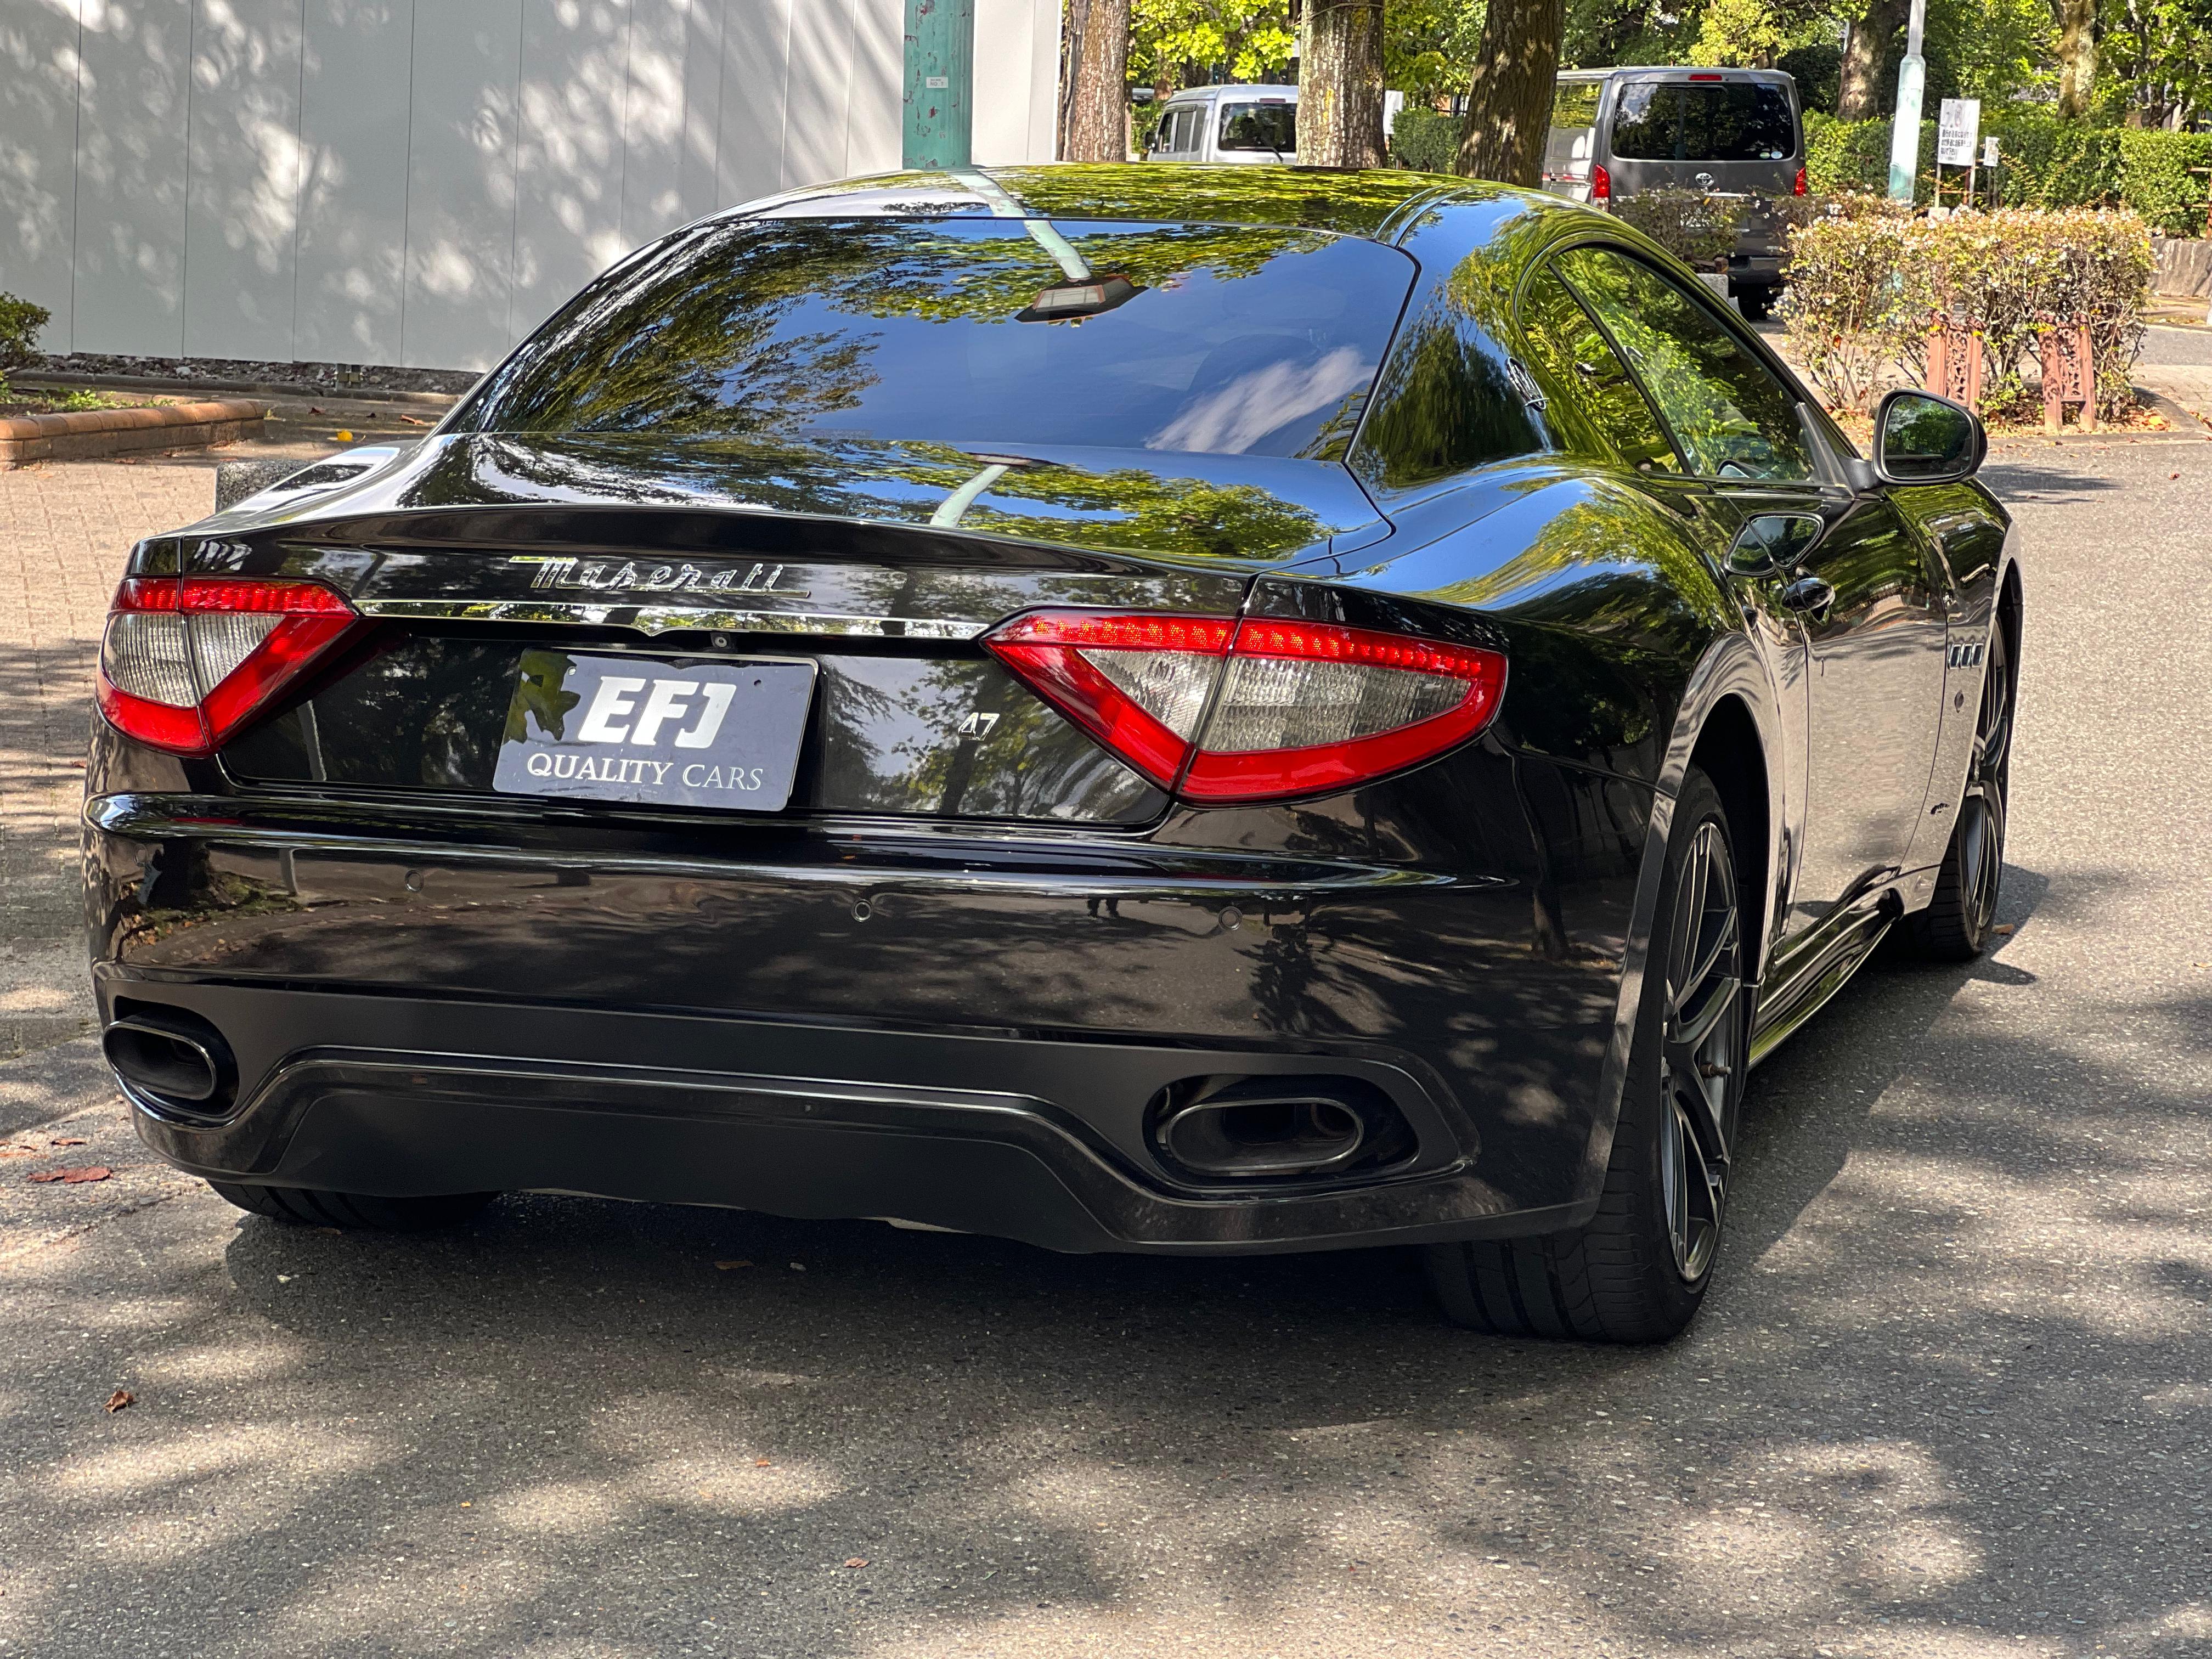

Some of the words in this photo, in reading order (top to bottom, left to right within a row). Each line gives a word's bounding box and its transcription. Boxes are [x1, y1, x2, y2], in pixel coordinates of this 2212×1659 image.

[509, 555, 810, 598] Maserati
[578, 676, 737, 749] EFJ
[527, 753, 674, 785] QUALITY
[682, 764, 764, 791] CARS
